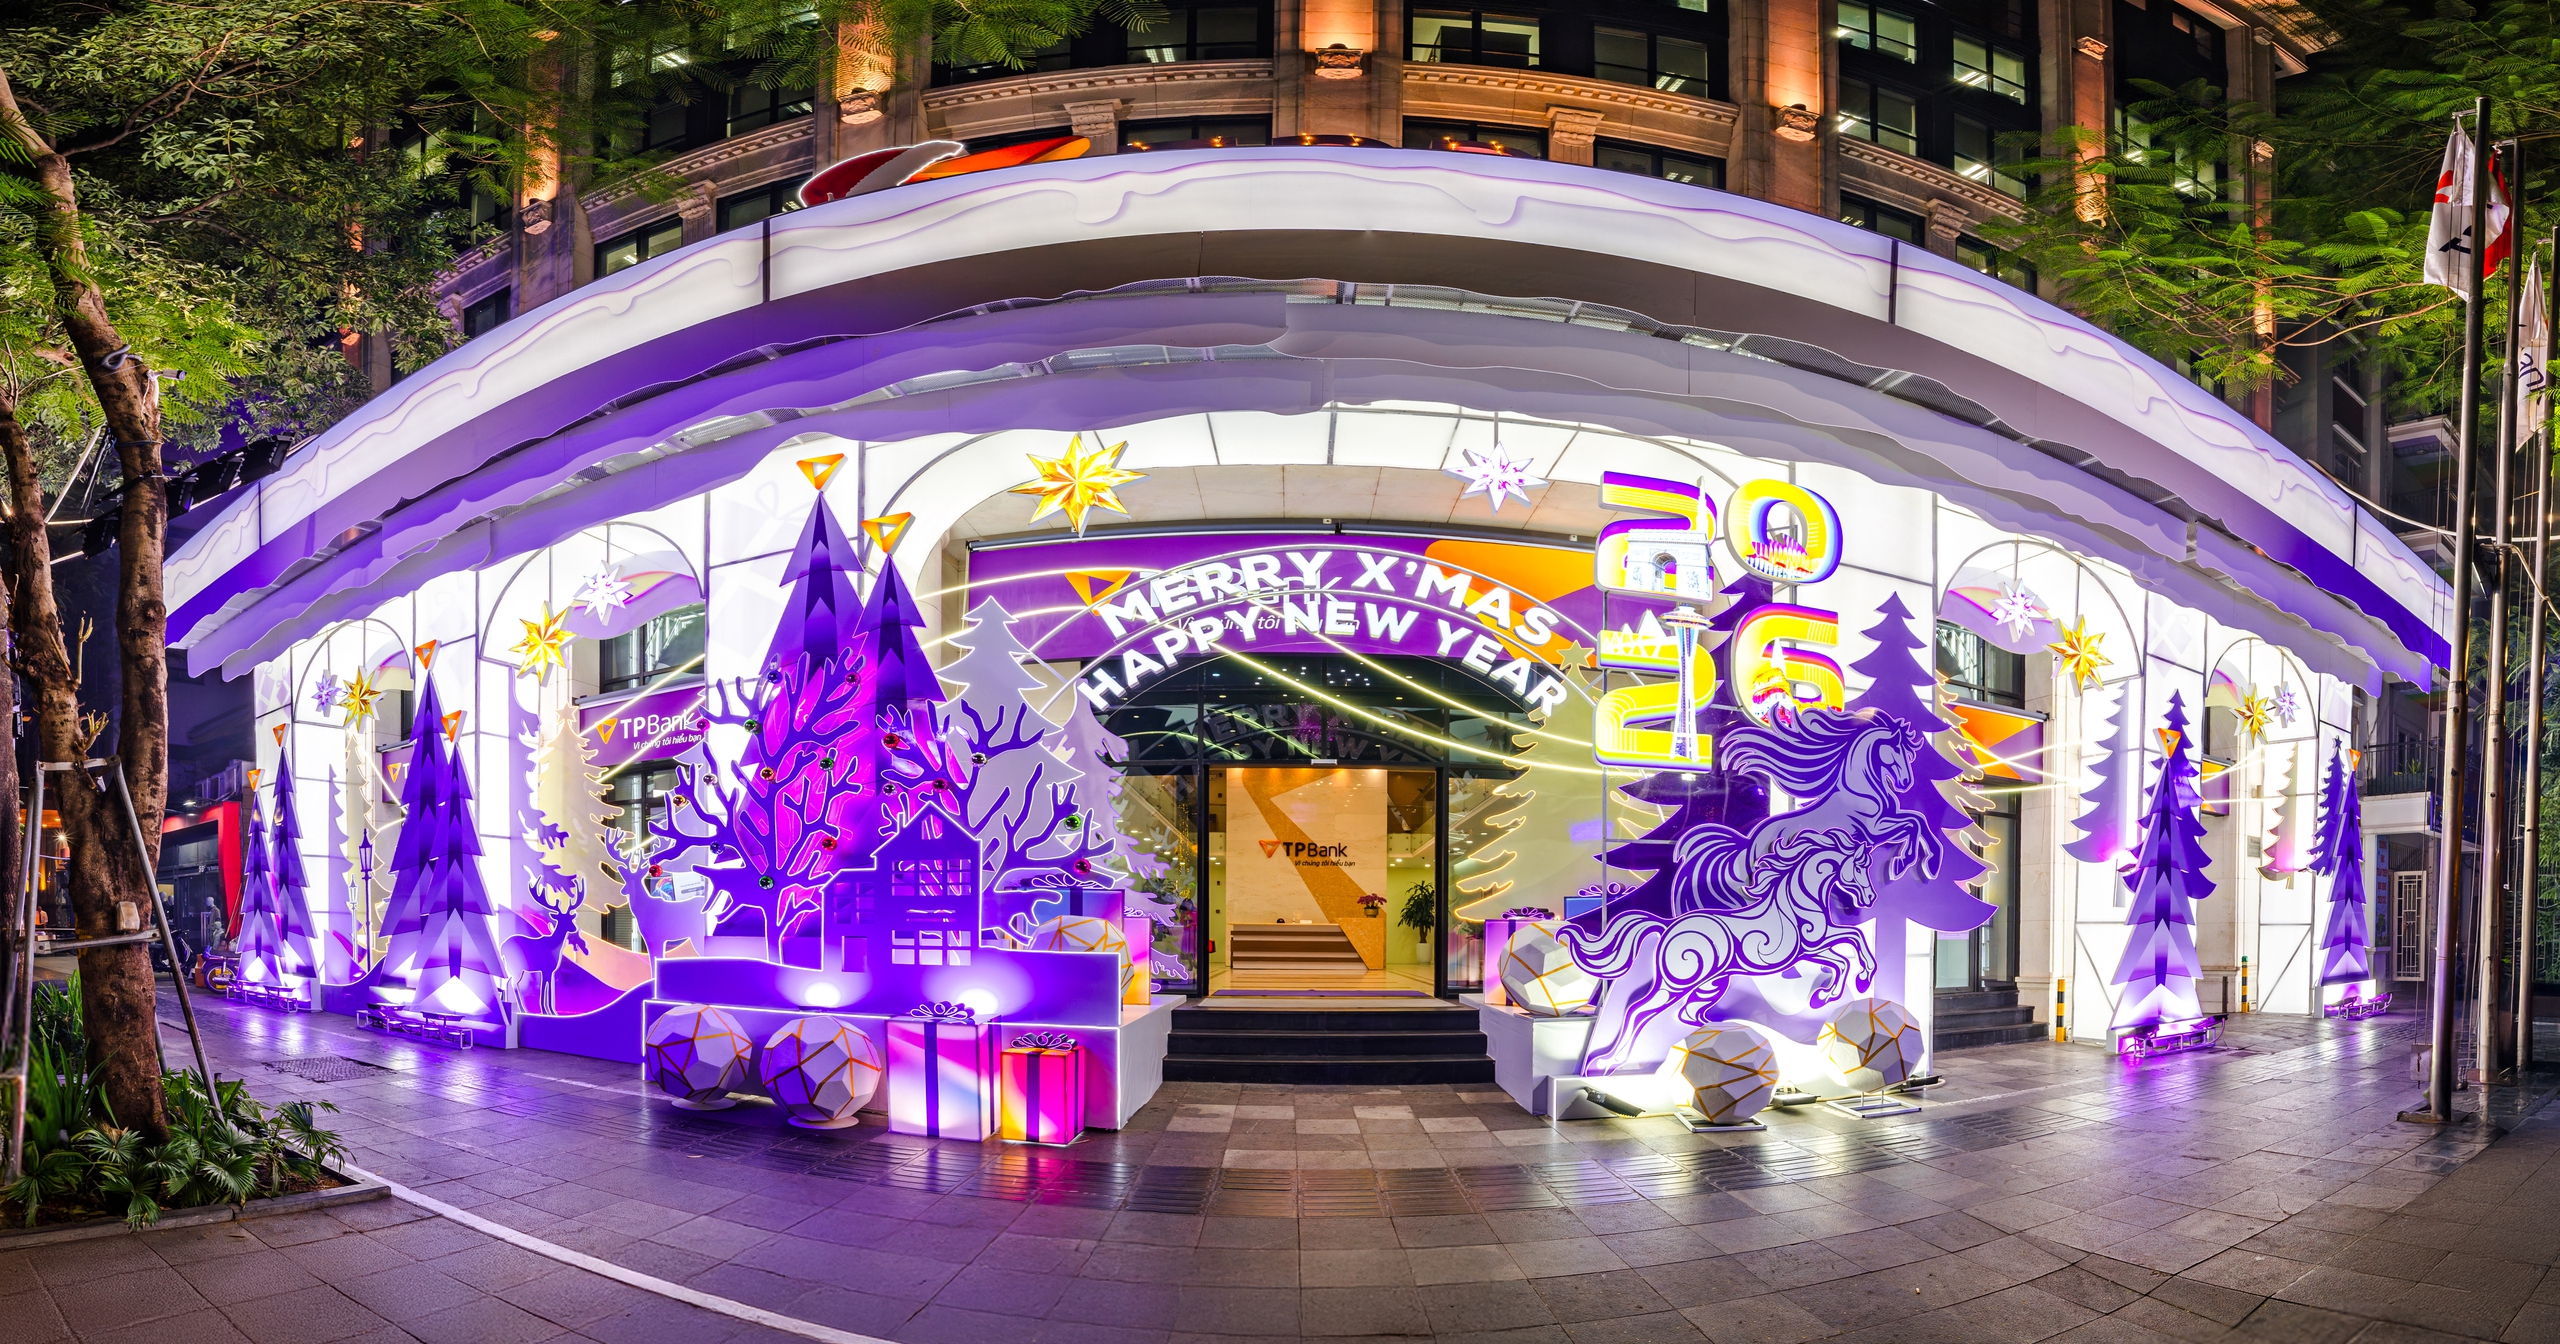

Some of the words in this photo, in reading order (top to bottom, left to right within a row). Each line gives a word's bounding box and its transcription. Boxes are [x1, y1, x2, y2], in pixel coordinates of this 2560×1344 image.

[1100, 551, 1333, 641] MERRY
[1257, 614, 1280, 630] tôi
[1076, 605, 1262, 713] HAPPY
[1282, 601, 1419, 643] NEW
[1437, 618, 1568, 718] YEAR
[620, 709, 695, 739] TPBank
[1283, 842, 1348, 858] TPBank
